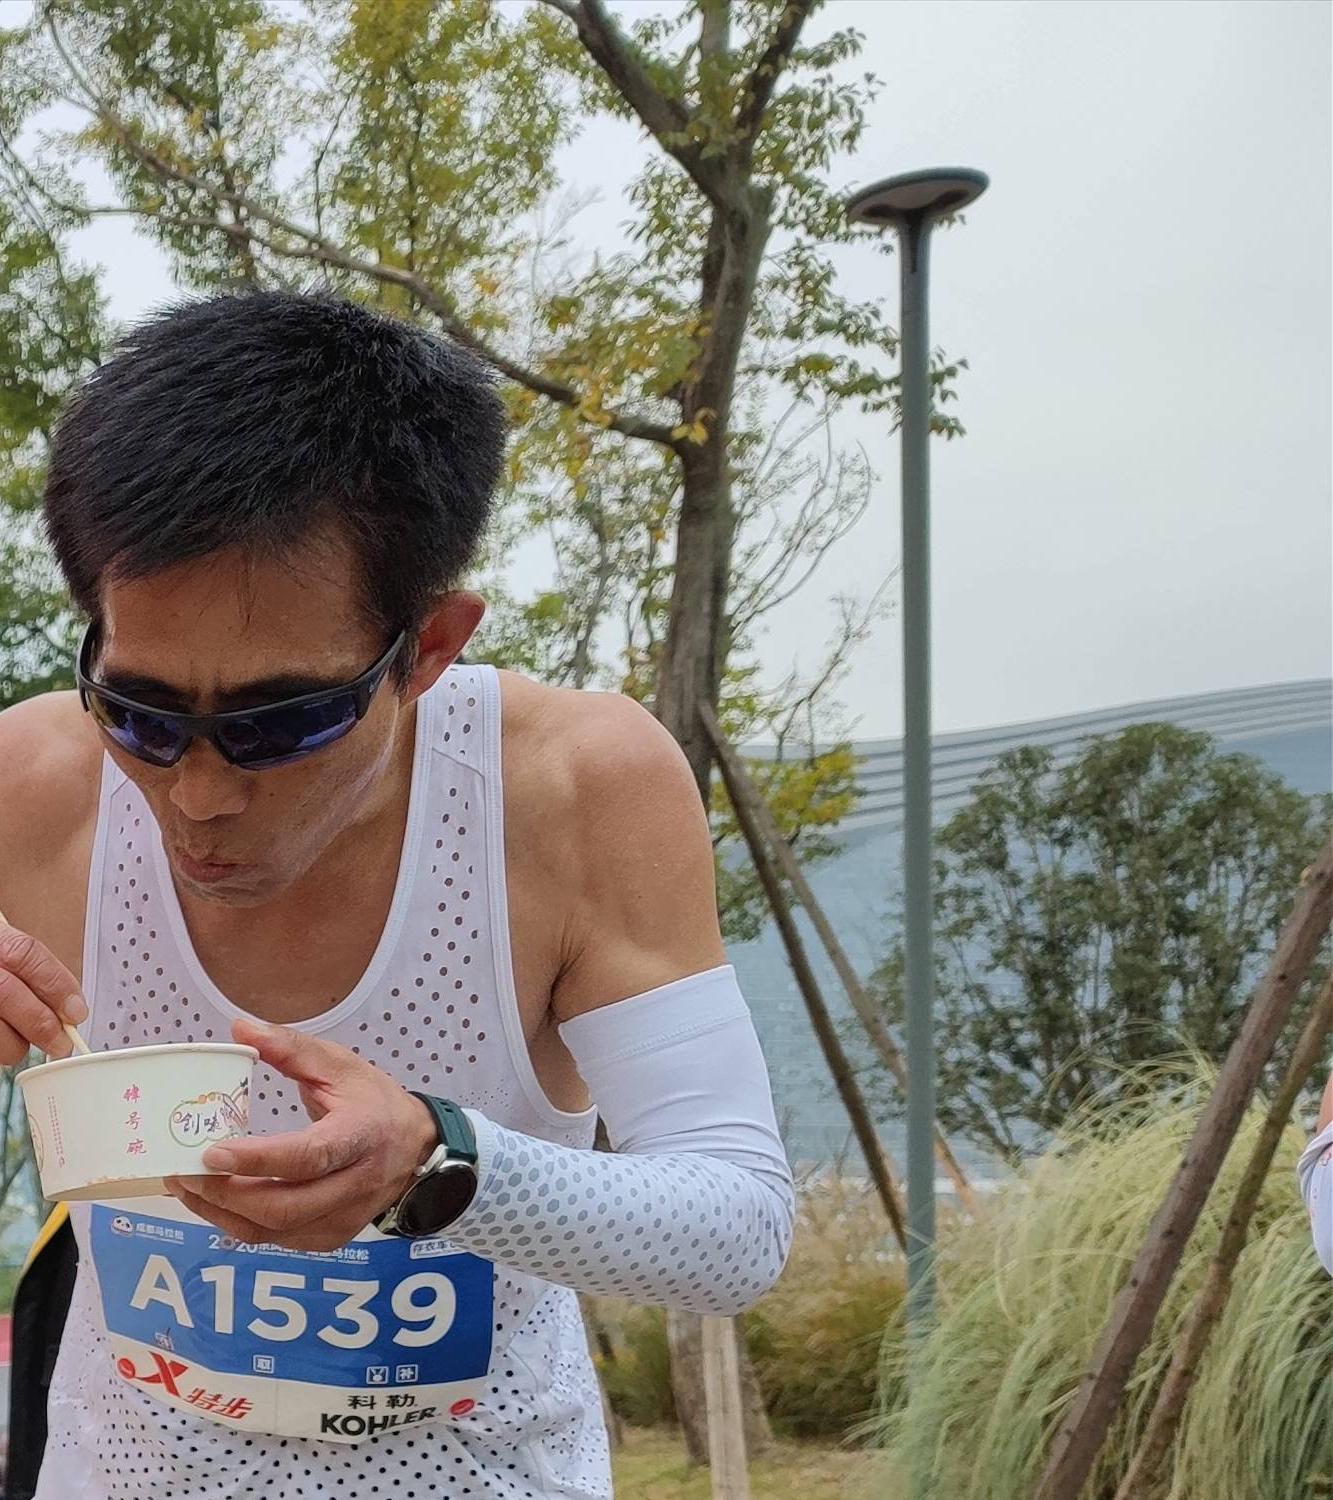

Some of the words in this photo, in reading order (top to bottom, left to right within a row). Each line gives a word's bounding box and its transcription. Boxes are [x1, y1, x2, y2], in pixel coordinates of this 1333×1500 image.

[130, 1255, 457, 1350] A1539
[184, 1387, 254, 1419] 特步
[347, 1394, 415, 1410] 科勒
[321, 1407, 437, 1436] KOHLER
